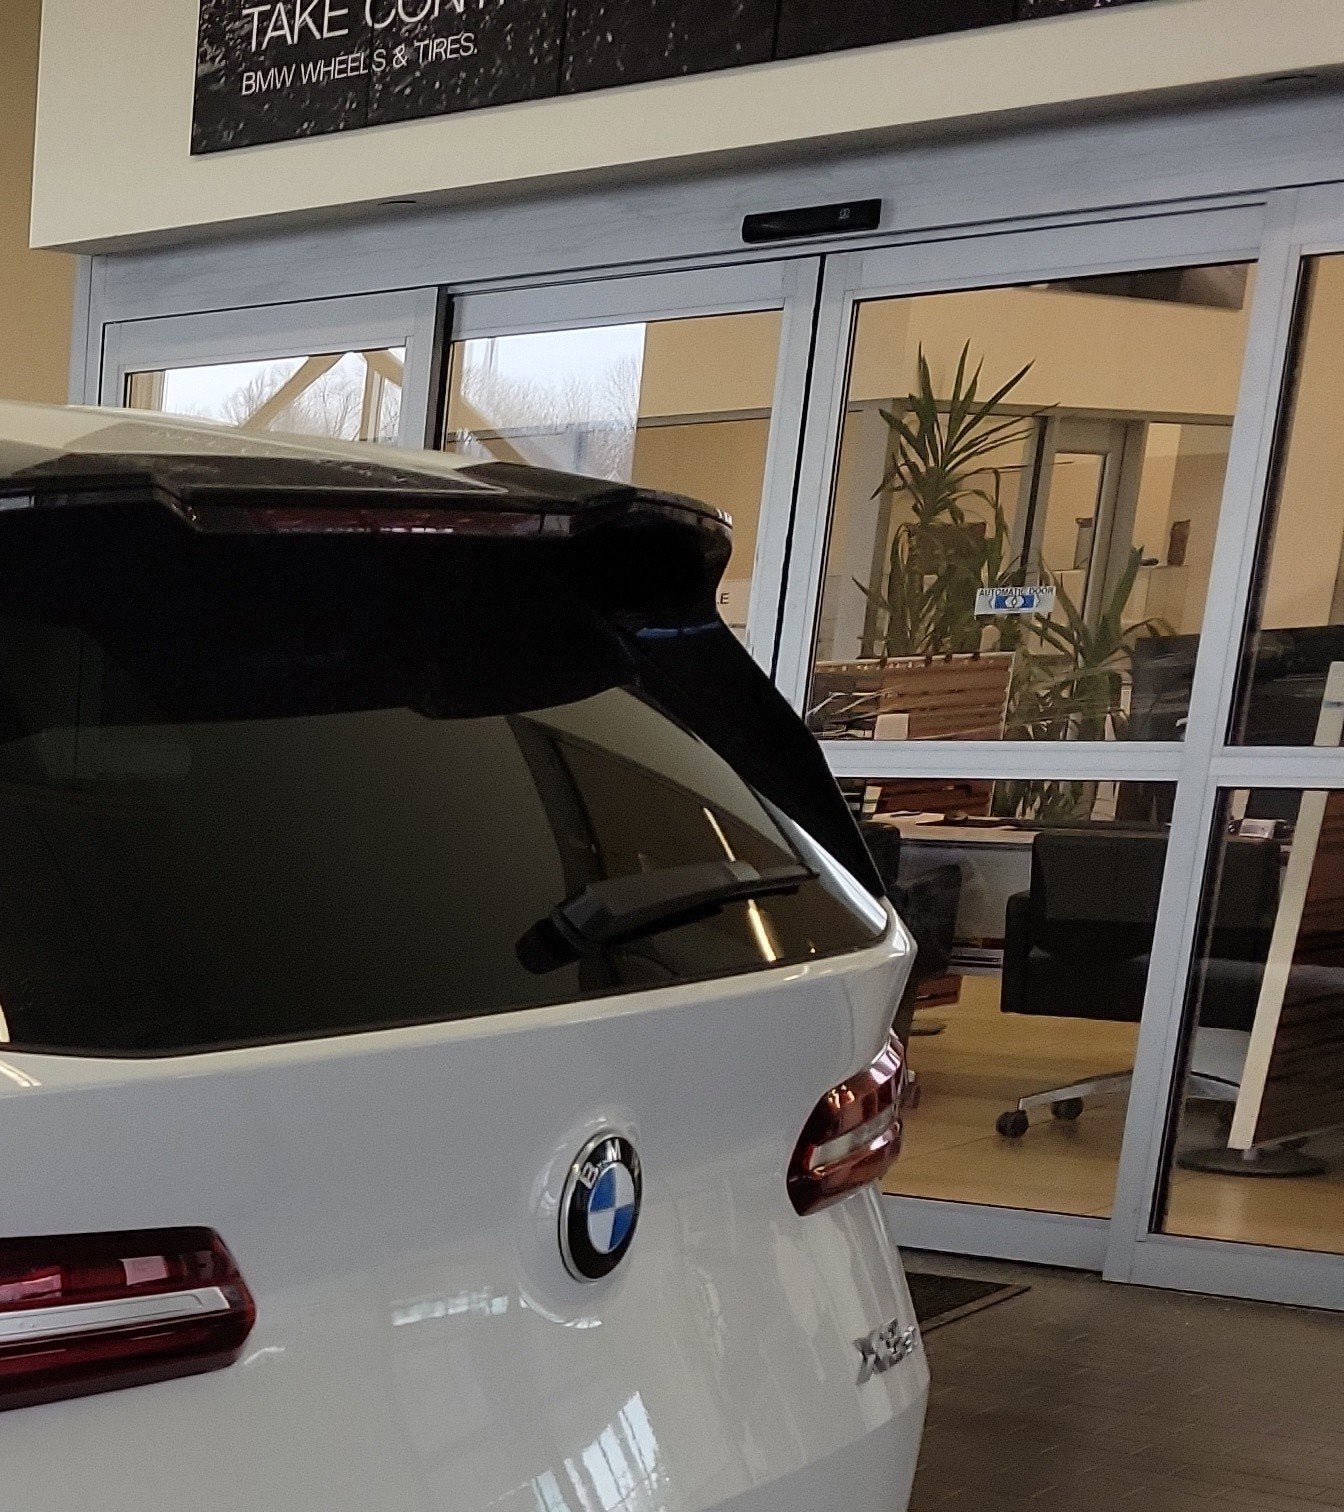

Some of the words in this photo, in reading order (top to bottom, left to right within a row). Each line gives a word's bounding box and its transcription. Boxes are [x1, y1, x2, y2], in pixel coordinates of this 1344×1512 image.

[242, 0, 349, 51] TAKE
[241, 63, 295, 96] BMW
[301, 50, 386, 85] WHEELS
[393, 45, 408, 68] &
[413, 32, 478, 65] TIRES.
